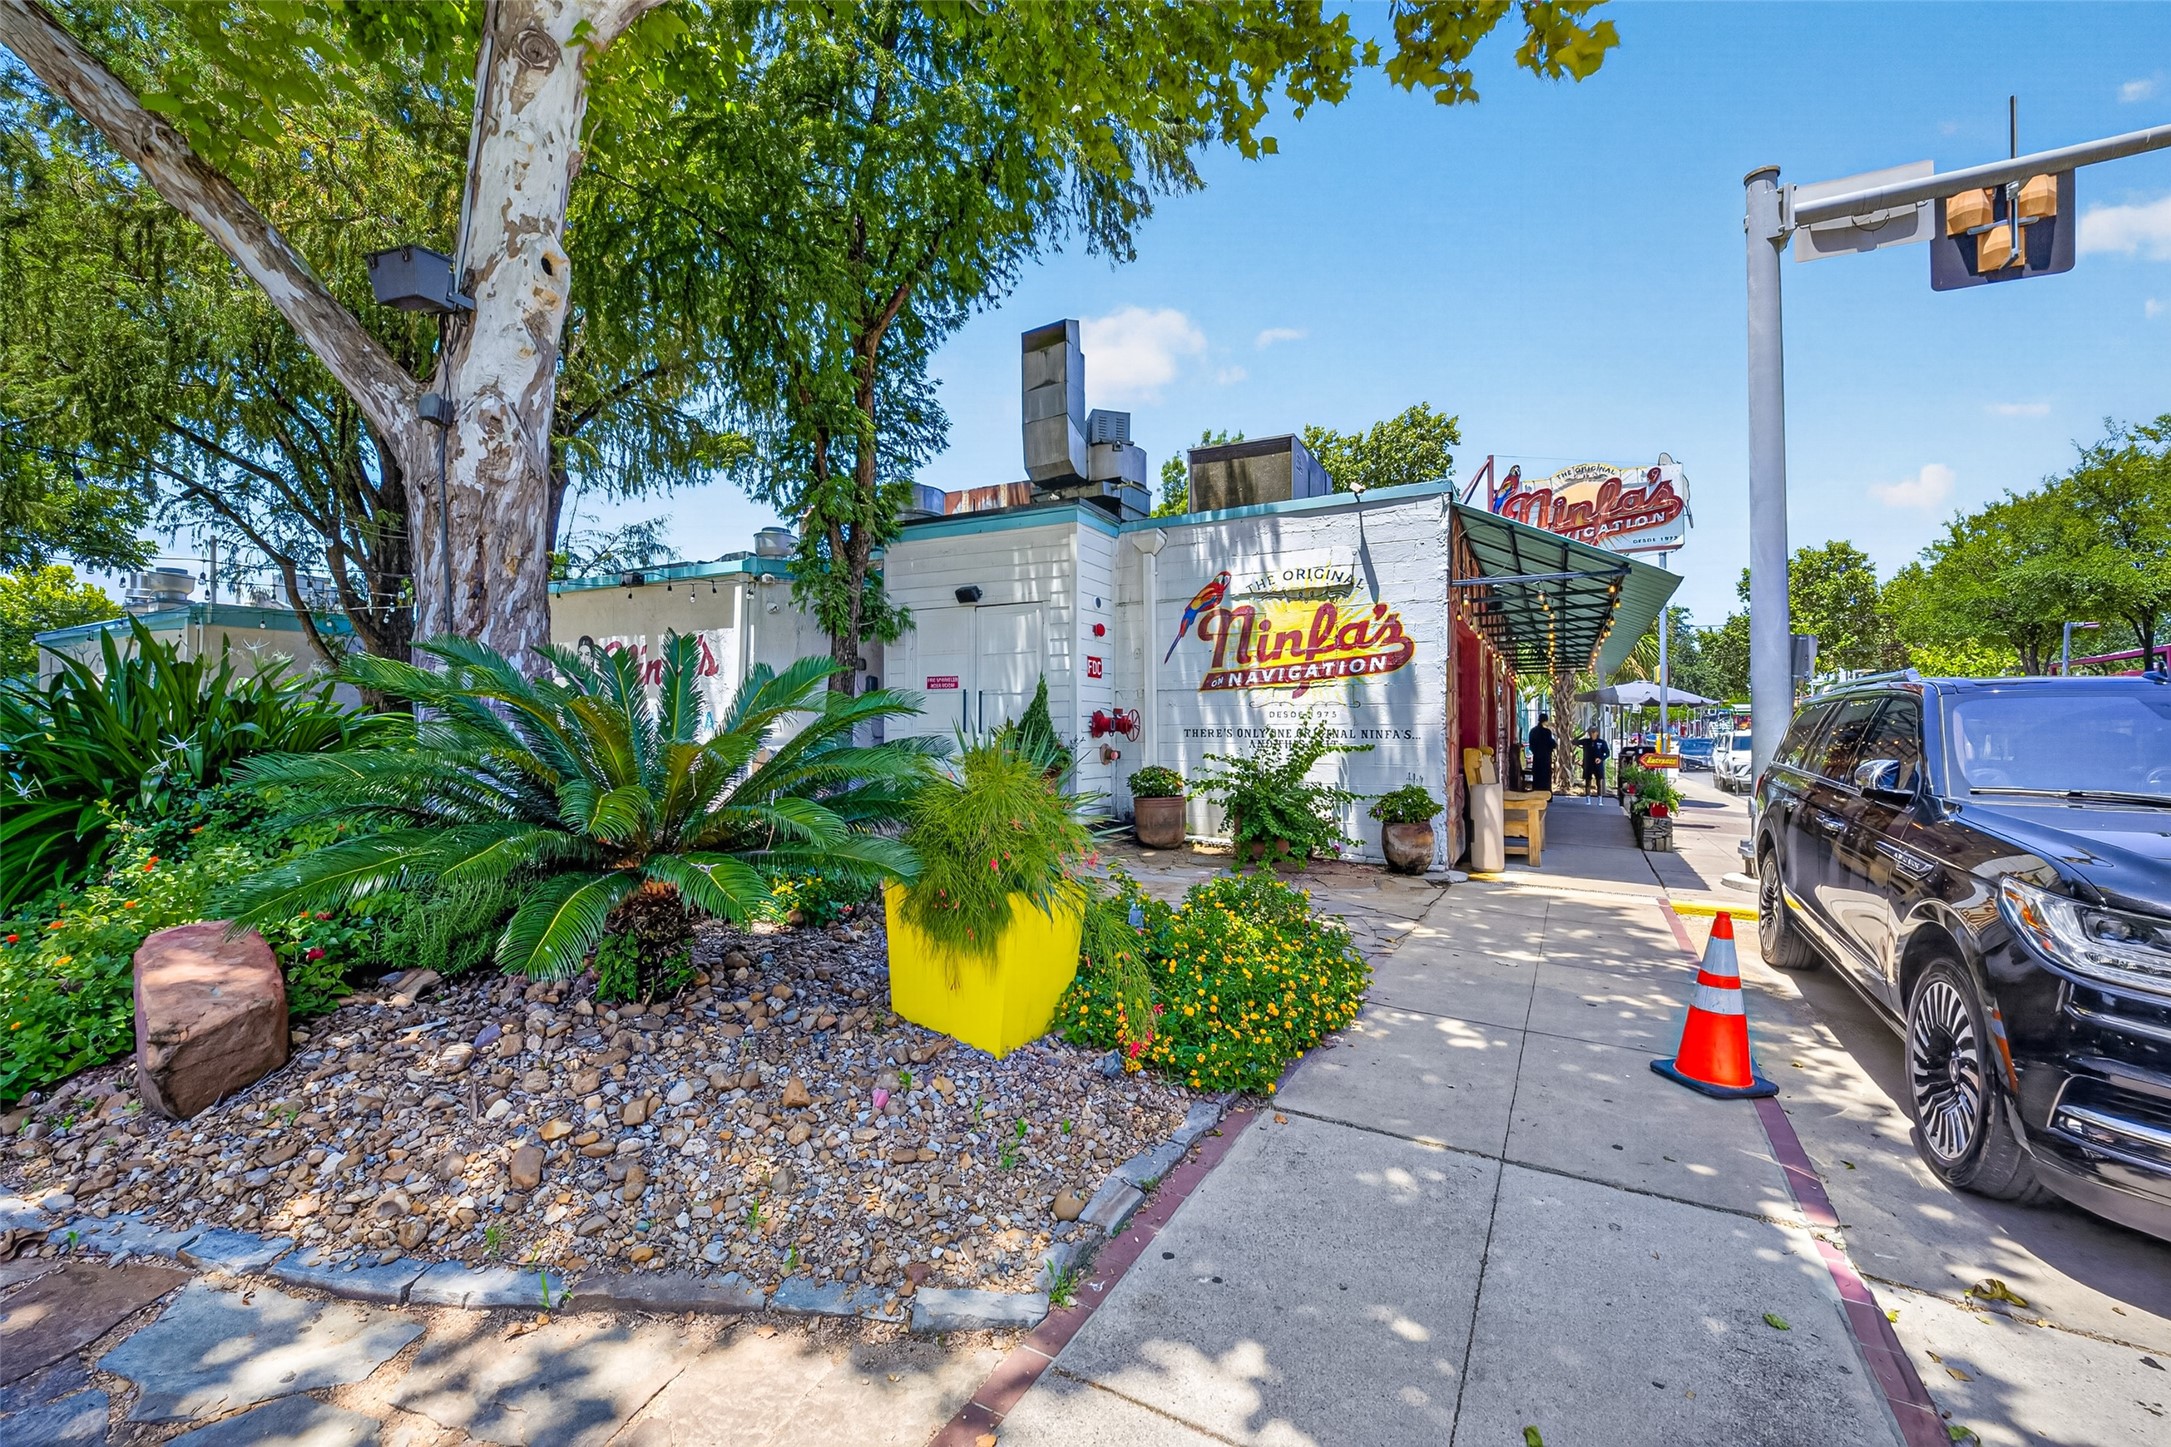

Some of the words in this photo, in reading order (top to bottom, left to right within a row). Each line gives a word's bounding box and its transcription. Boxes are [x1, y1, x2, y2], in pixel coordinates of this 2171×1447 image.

[1556, 470, 1573, 480] THE
[1575, 464, 1616, 476] ORIGINAL
[1502, 467, 1681, 533] Ninfa's
[1246, 575, 1276, 594] THE
[1283, 568, 1365, 590] ORIGINAL
[1198, 602, 1405, 669] Ninfa's
[1087, 659, 1102, 676] FDC
[1211, 676, 1224, 688] ON
[1228, 655, 1387, 687] NAVIGATION
[1184, 728, 1233, 738] THERE'S
[1237, 728, 1266, 738] ONLY
